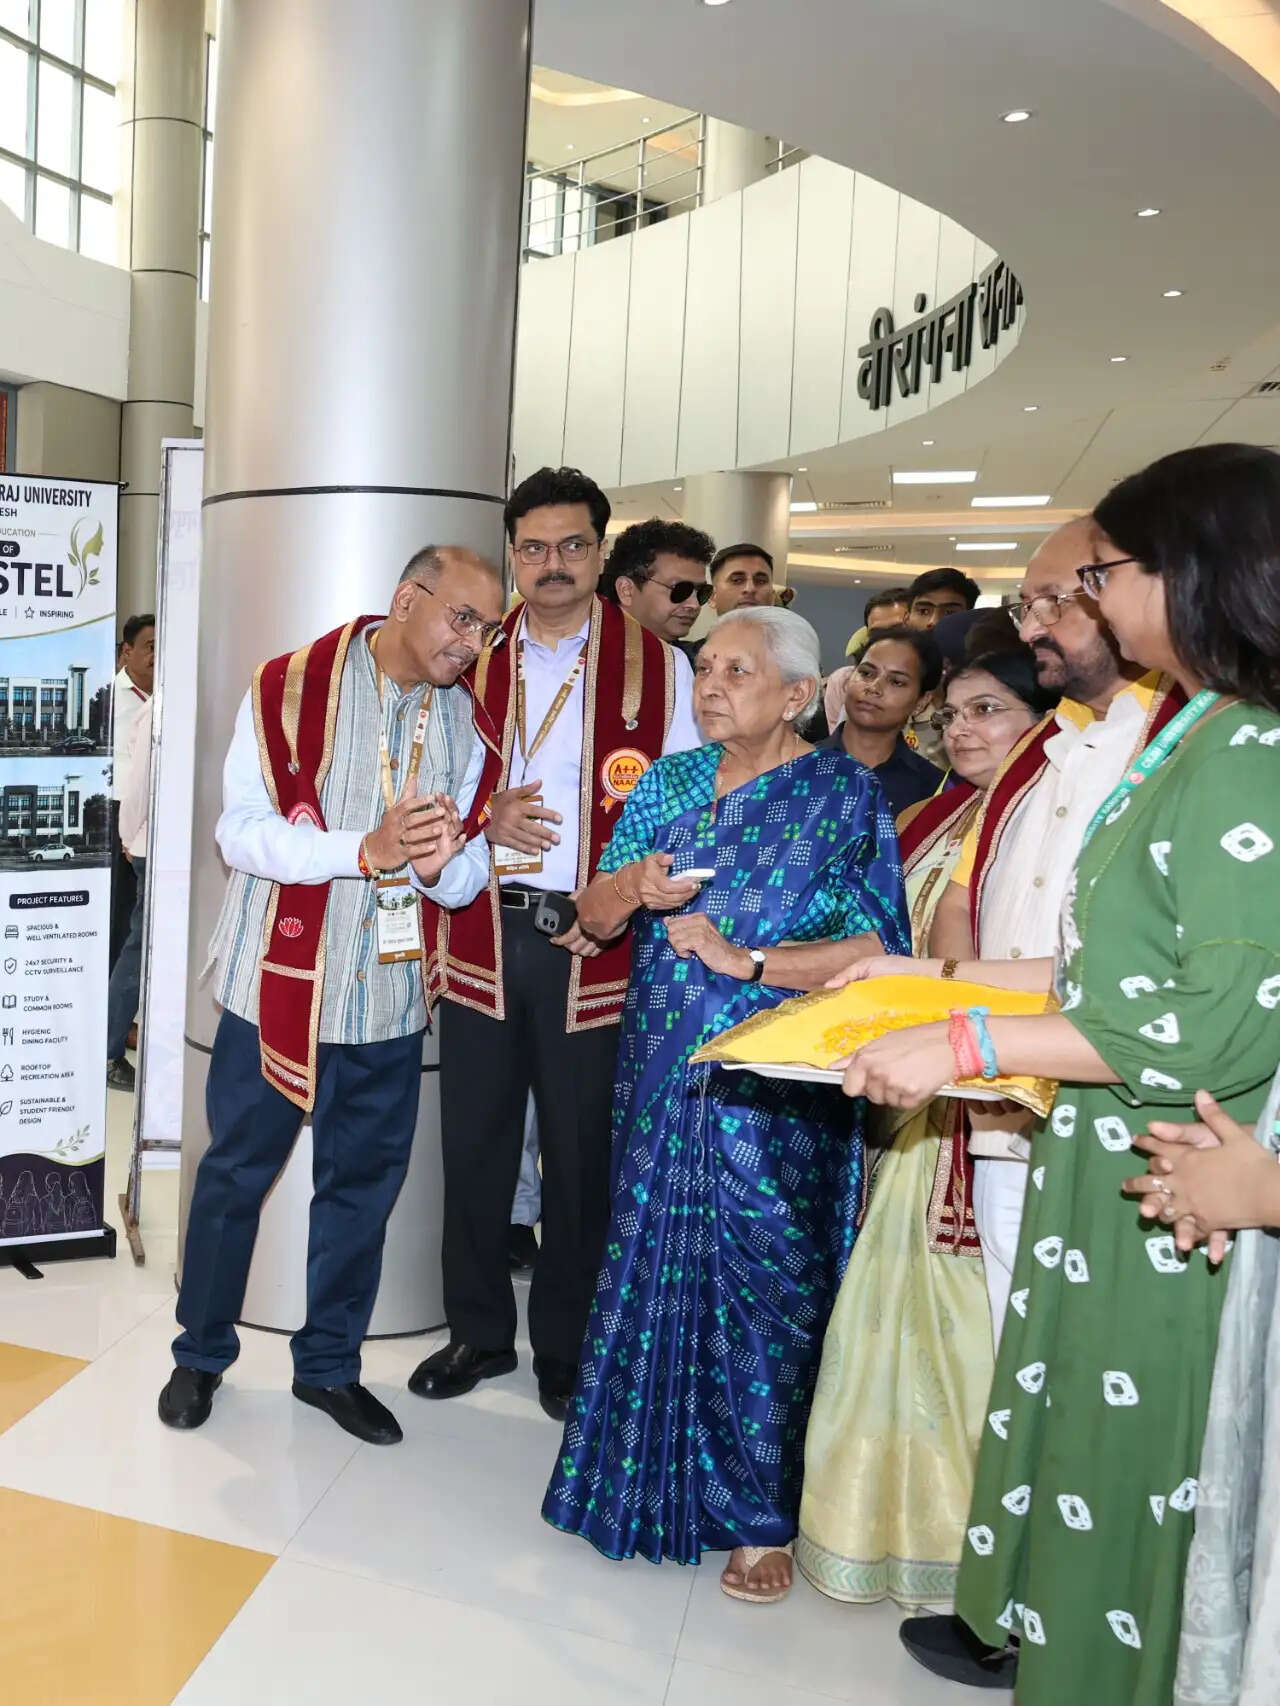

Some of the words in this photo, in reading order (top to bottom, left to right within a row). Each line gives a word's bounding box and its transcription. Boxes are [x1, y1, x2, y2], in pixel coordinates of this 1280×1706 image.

[24, 485, 92, 507] UNIVERSITY
[2, 545, 14, 554] OF
[40, 609, 74, 619] INSPIRING
[614, 764, 639, 774] A++
[17, 897, 48, 905] PROJECT
[49, 895, 84, 903] FEATURES
[43, 932, 76, 940] VENTILATED
[41, 958, 67, 966] SECURITY
[43, 966, 84, 975] SURVEILLANCE
[20, 1073, 60, 1081] RECREATION
[19, 1097, 61, 1105] SUSTAINABLE
[19, 1107, 47, 1115] STUDENT
